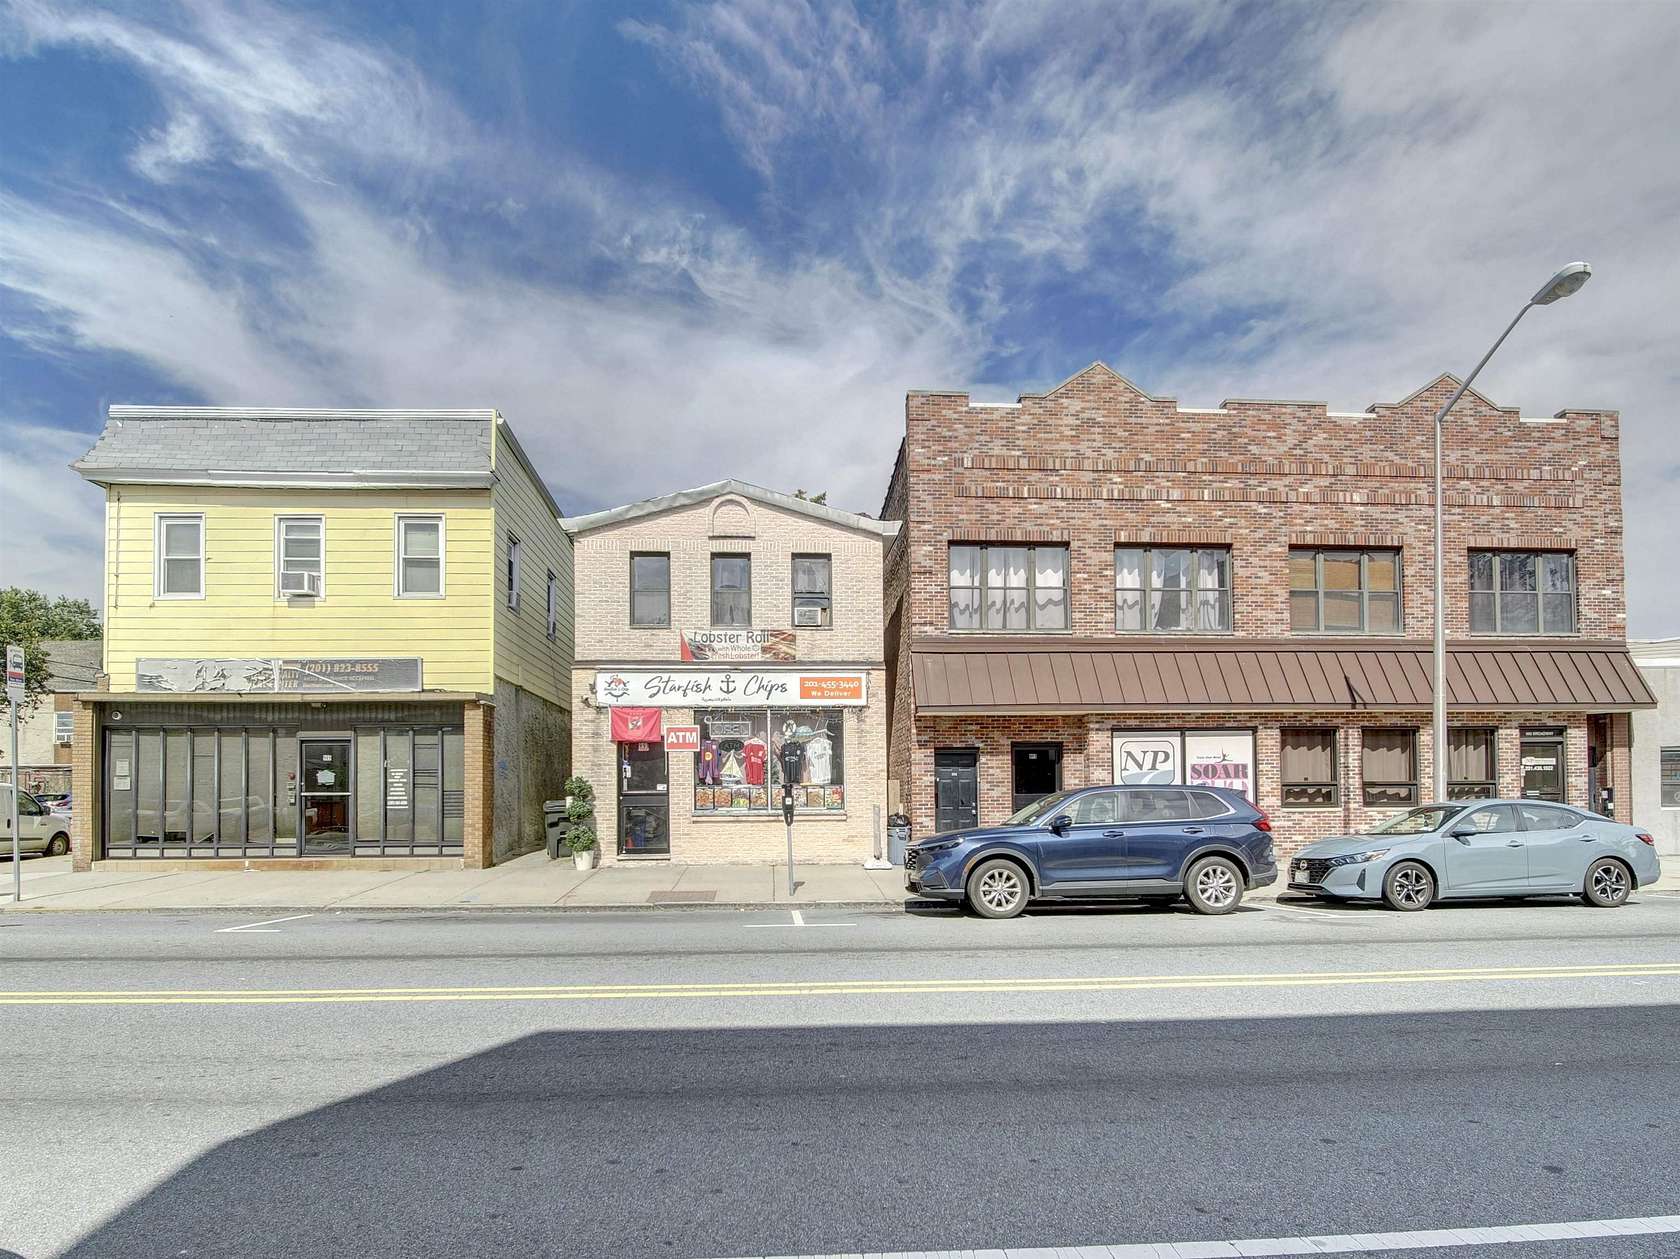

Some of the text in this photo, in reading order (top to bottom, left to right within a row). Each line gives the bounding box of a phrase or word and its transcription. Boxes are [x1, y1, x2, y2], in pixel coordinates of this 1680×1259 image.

[694, 630, 770, 644] Lobster Roll
[644, 674, 788, 700] Starfish Chips
[667, 731, 697, 743] ATM
[1121, 750, 1170, 771] NP
[1190, 763, 1248, 780] SOAR
